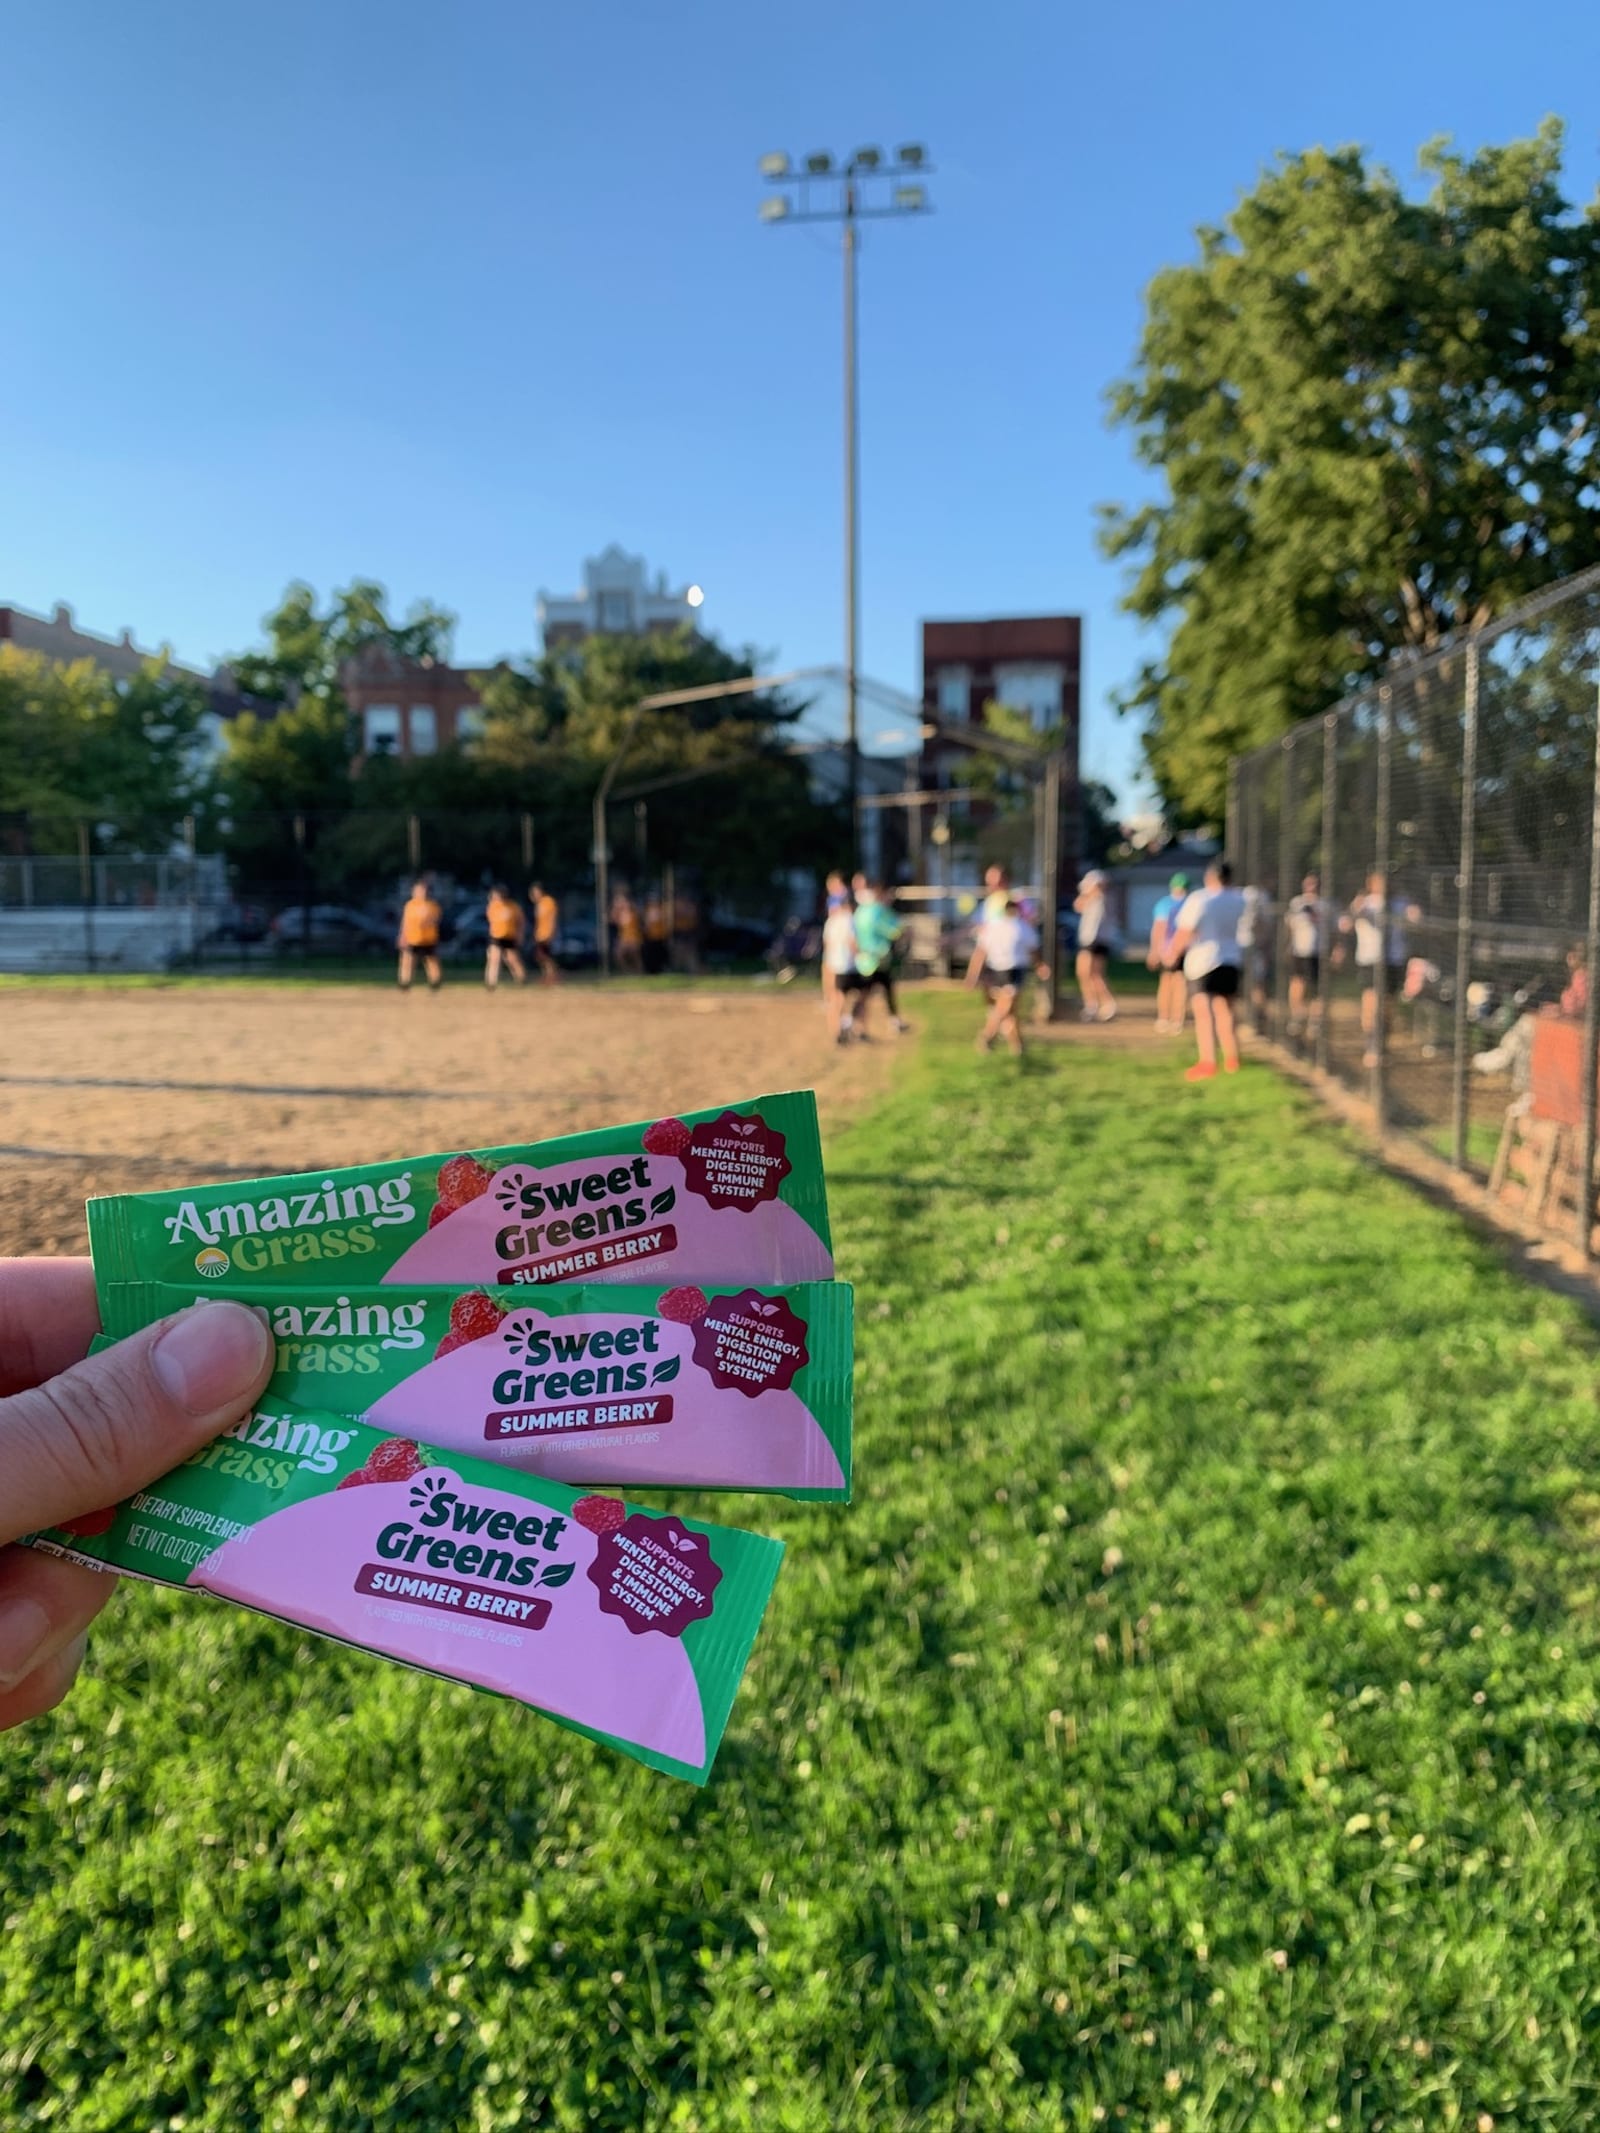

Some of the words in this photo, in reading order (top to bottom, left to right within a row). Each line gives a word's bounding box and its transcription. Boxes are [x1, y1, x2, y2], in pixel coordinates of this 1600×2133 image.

[691, 1145, 737, 1160] MENTAL
[740, 1152, 782, 1169] ENERGY,
[705, 1160, 766, 1176] DIGESTION
[712, 1137, 765, 1153] SUPPORTS
[520, 1156, 652, 1219] Sweet
[705, 1171, 714, 1181] &
[717, 1172, 764, 1188] IMMUNE
[164, 1172, 415, 1244] Amazing
[495, 1198, 647, 1260] Greens
[231, 1224, 376, 1271] Grass
[512, 1251, 599, 1285] SUMMER
[602, 1232, 663, 1262] BERRY
[525, 1320, 660, 1367] Sweet
[704, 1317, 750, 1340] MENTAL
[753, 1333, 800, 1359] ENERGY,
[728, 1312, 785, 1338] SUPPORTS
[275, 1343, 381, 1374] rass
[714, 1347, 724, 1358] &
[726, 1350, 777, 1375] IMMUNE
[716, 1334, 782, 1364] DIGESTION
[492, 1362, 648, 1405] Greens
[499, 1408, 589, 1434] SUMMER
[594, 1401, 660, 1424] BERRY
[184, 1442, 295, 1489] rass
[222, 1411, 359, 1474] azing
[130, 1492, 181, 1522] DIETARY
[176, 1506, 256, 1545] SUPPLEMENT
[419, 1492, 567, 1551] Sweet
[126, 1523, 149, 1548] NET
[146, 1529, 168, 1555] WT
[162, 1536, 186, 1561] 0.17
[180, 1540, 201, 1565] OZ
[376, 1522, 540, 1586] Greens
[639, 1536, 695, 1580] SUPPORTS
[611, 1567, 622, 1580] &
[622, 1574, 674, 1616] IMMUNE
[612, 1532, 657, 1571] MENTAL
[657, 1565, 705, 1608] ENERGY,
[619, 1555, 683, 1606] DIGESTION
[370, 1571, 463, 1606] SUMMER
[464, 1591, 536, 1620] BERRY
